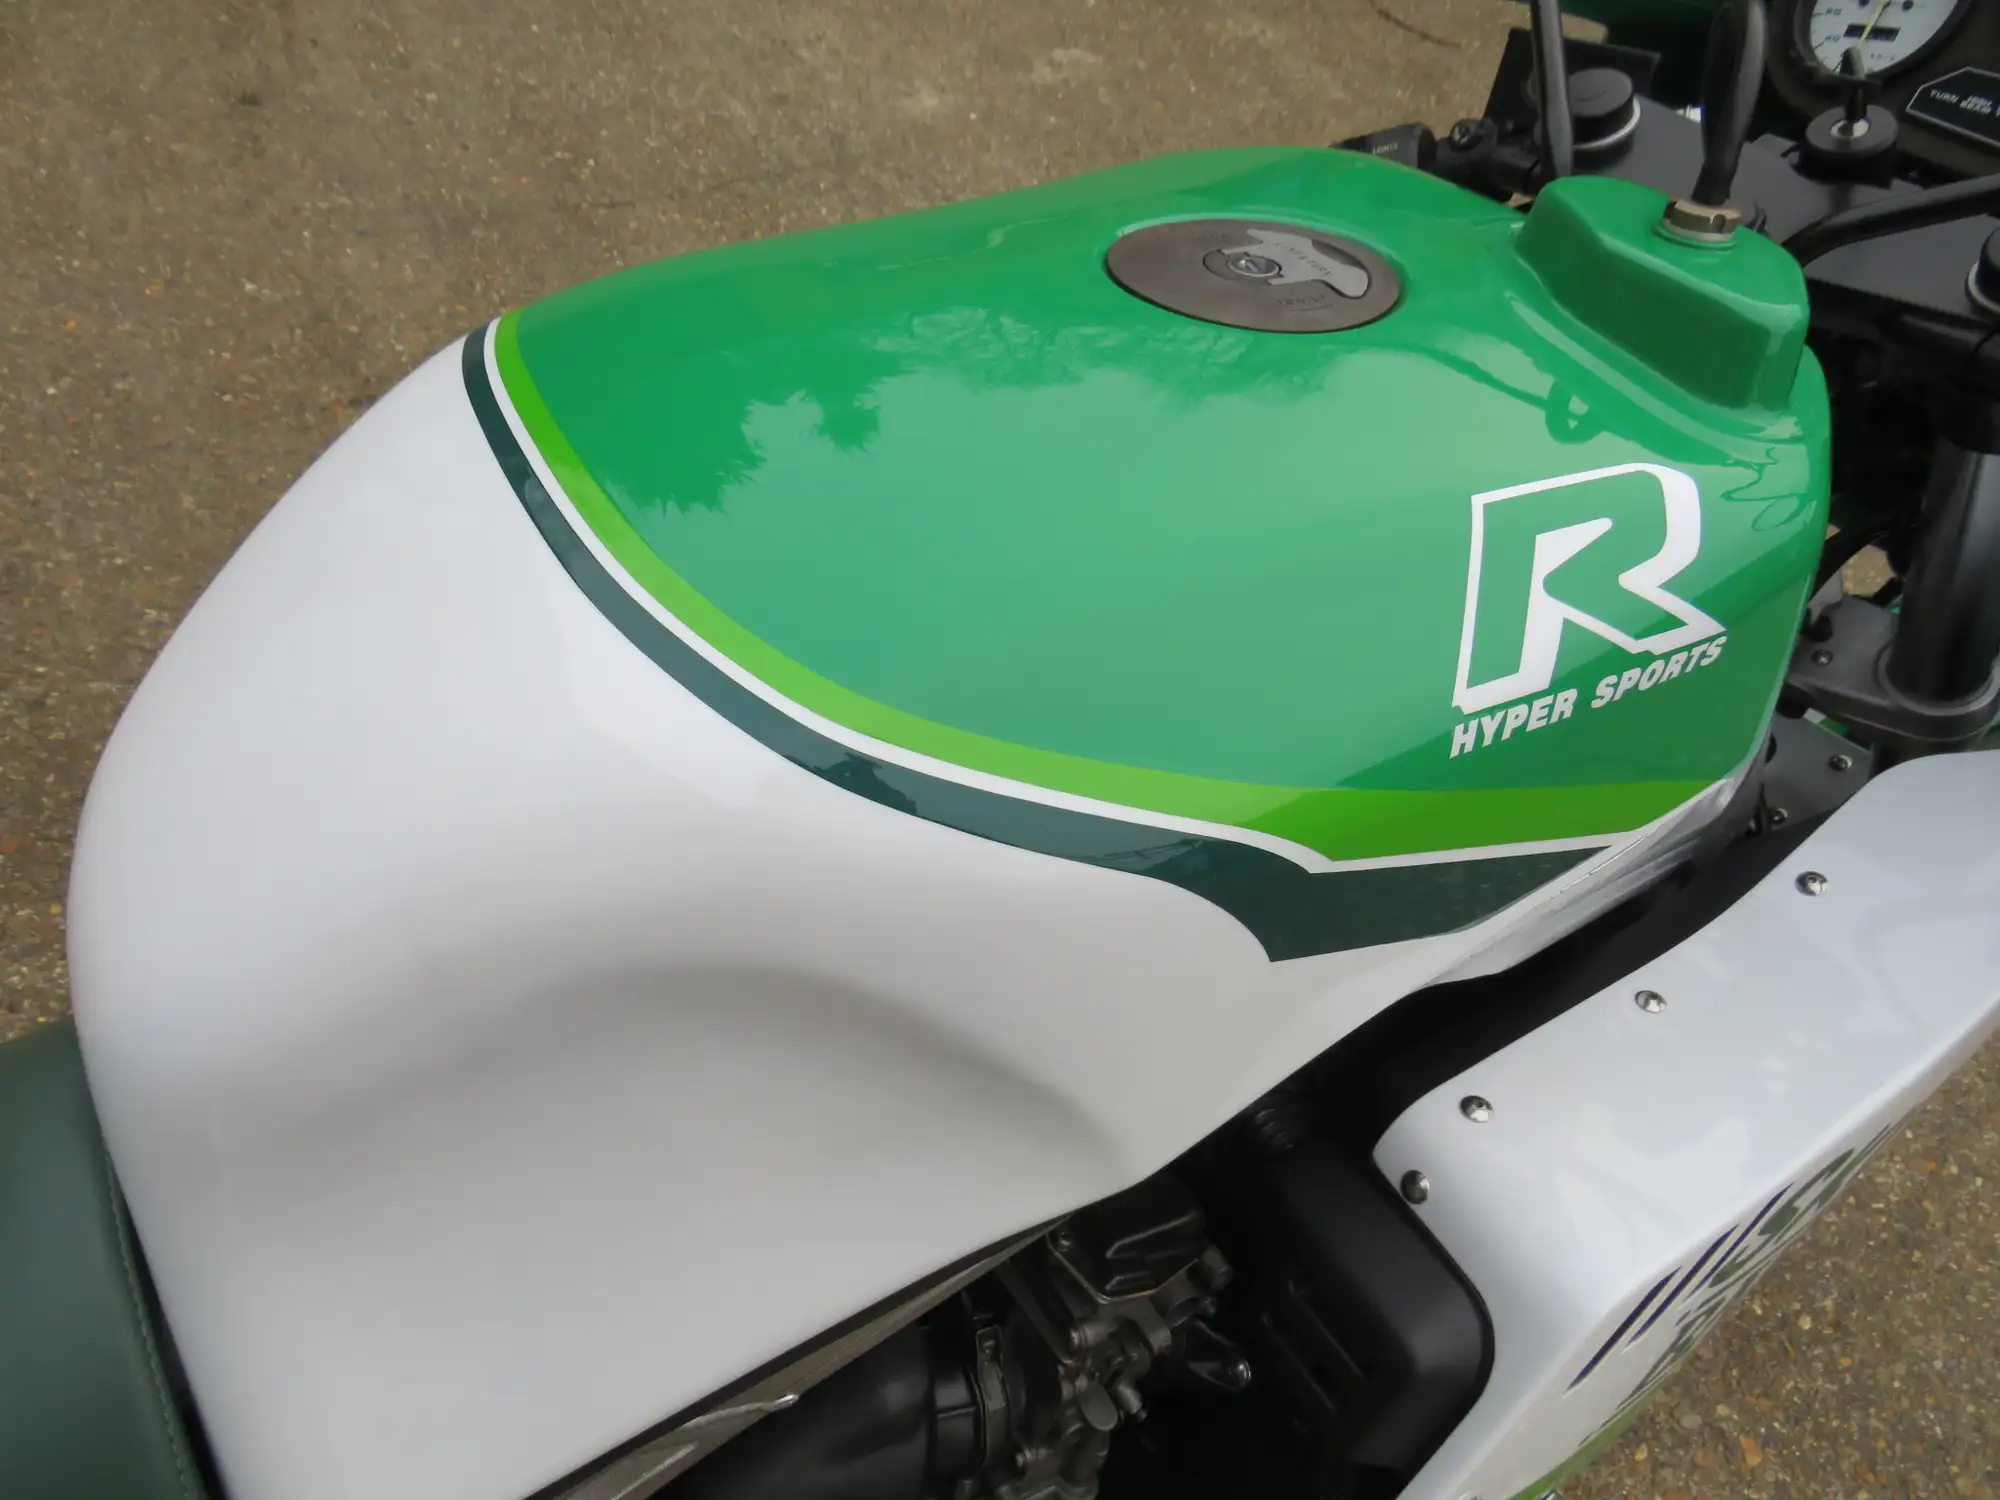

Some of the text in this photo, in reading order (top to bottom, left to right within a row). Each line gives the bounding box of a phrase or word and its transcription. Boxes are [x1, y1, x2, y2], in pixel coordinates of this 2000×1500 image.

[1930, 89, 1960, 104] TURN
[1452, 462, 1728, 714] R
[1449, 636, 1728, 759] HYPER SPORTS
